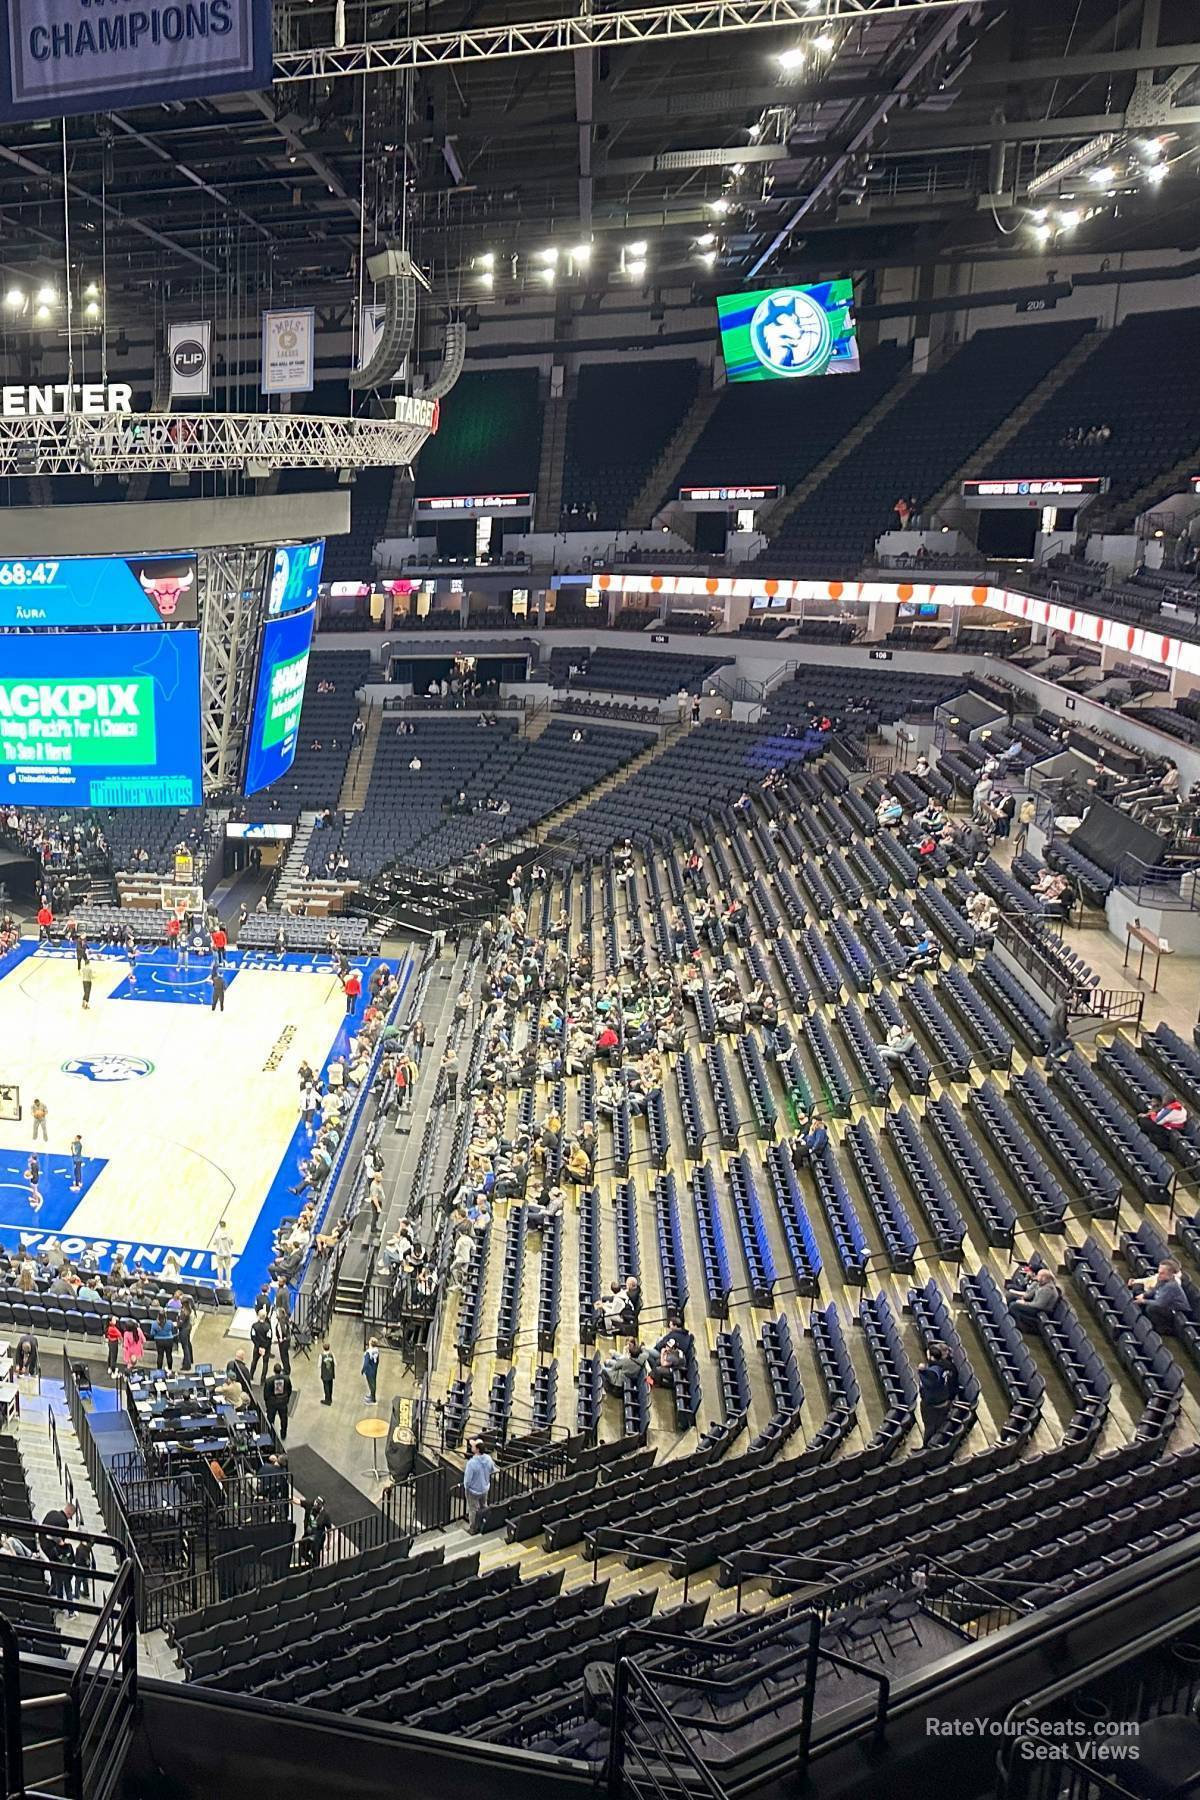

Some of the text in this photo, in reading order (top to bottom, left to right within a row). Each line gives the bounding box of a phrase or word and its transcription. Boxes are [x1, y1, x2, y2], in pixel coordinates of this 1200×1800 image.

[29, 0, 234, 61] CHAMPIONS
[175, 354, 203, 365] FLIP
[91, 780, 193, 805] Timberwolves
